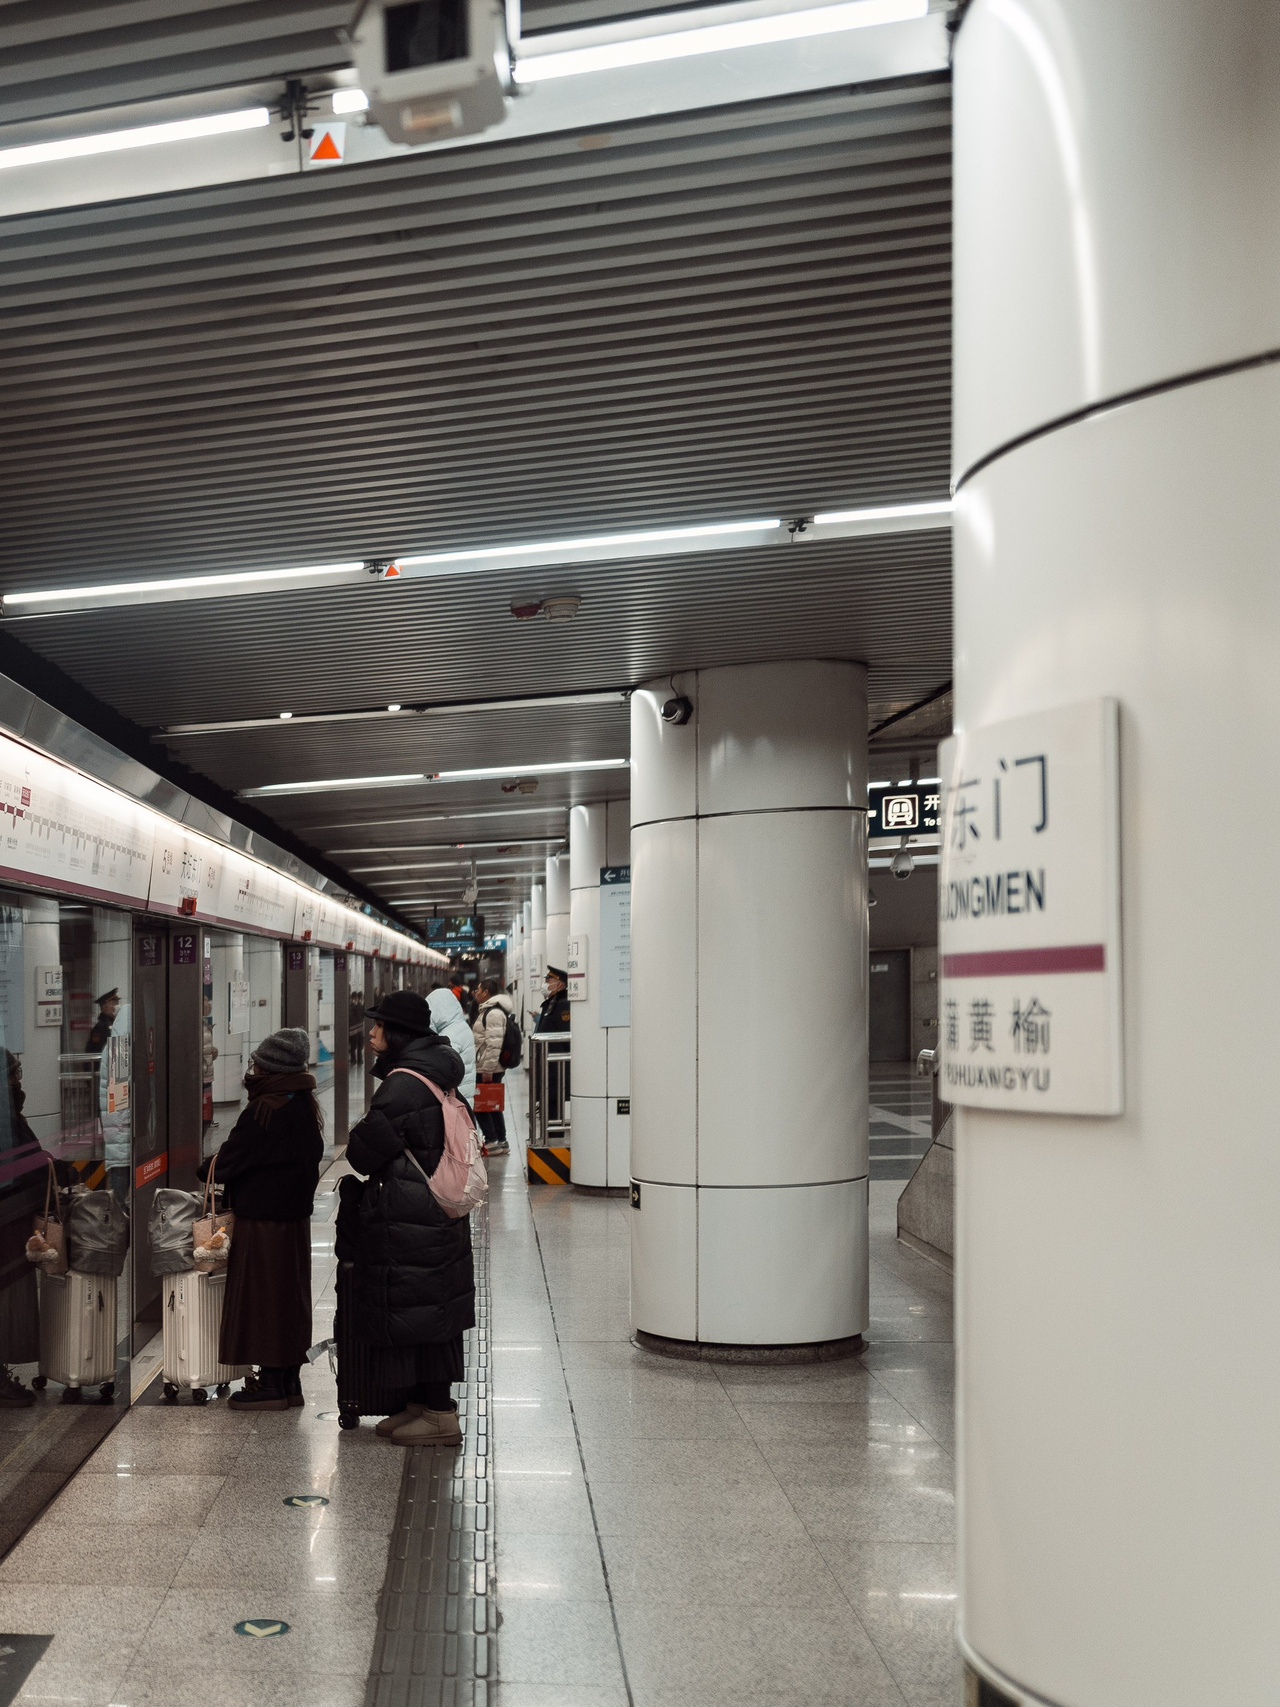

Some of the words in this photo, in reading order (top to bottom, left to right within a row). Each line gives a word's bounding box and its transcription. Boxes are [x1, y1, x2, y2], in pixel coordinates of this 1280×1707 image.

[923, 817, 936, 827] To
[178, 936, 193, 948] 12
[292, 952, 302, 960] 13
